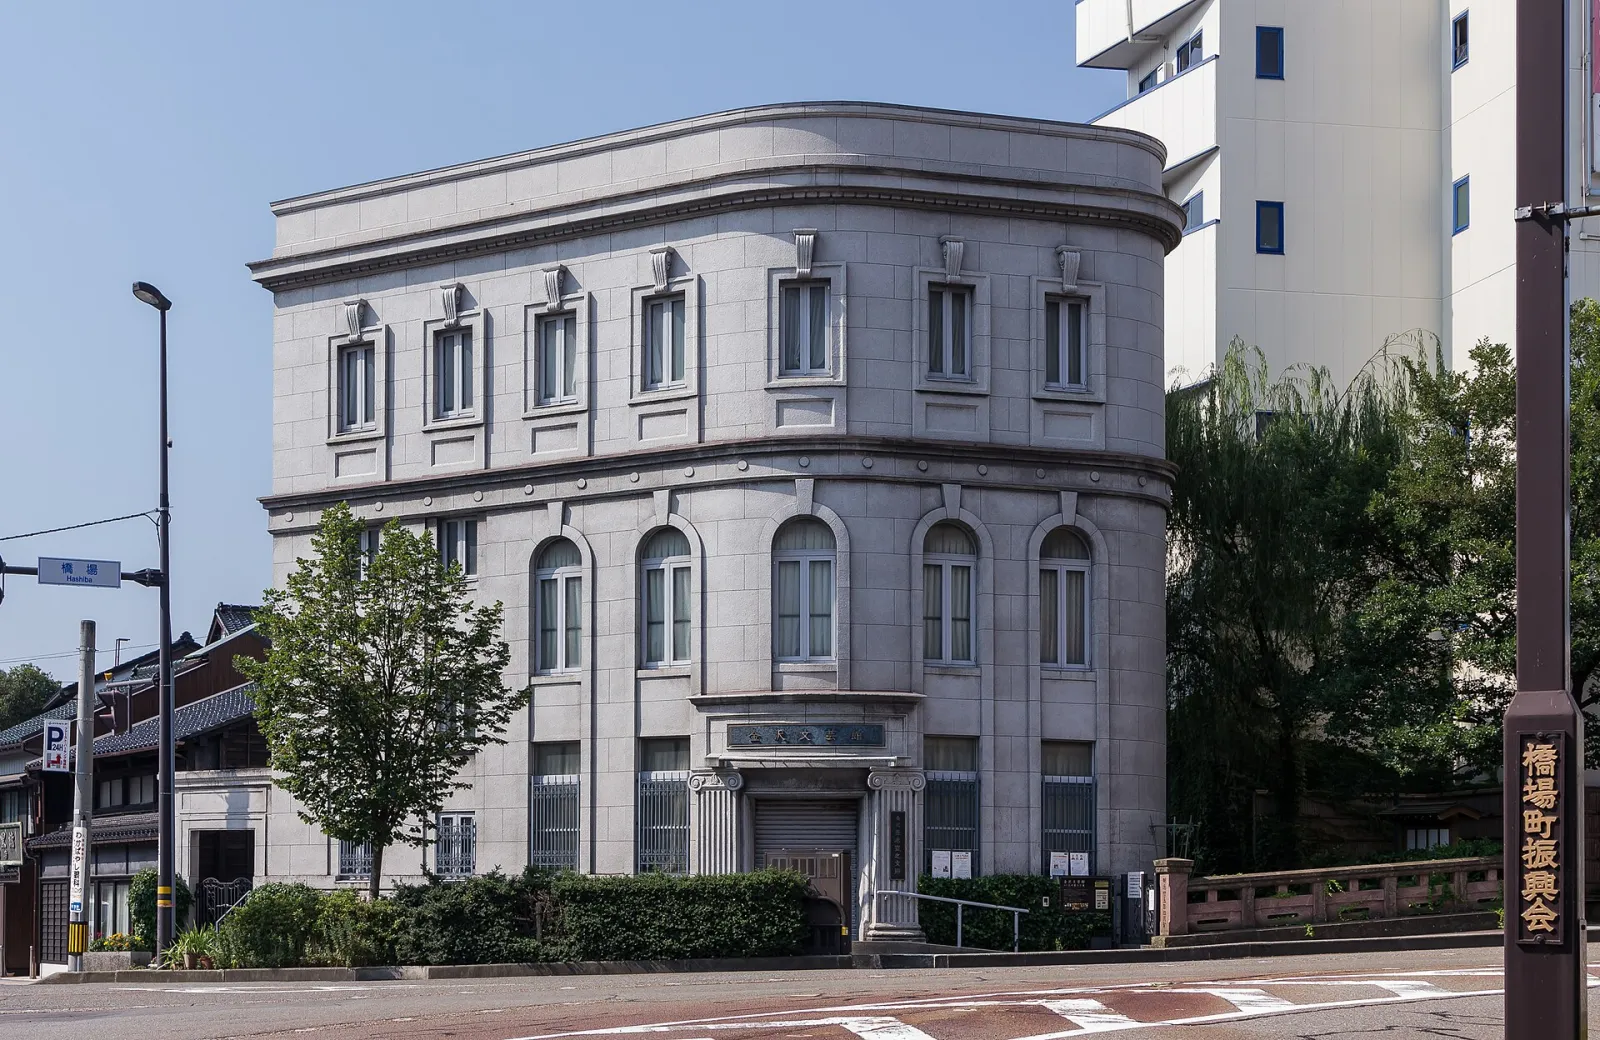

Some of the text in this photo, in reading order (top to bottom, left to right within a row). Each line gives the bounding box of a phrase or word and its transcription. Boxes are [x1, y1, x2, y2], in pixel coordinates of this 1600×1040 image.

[66, 575, 93, 583] Hashiba
[47, 726, 64, 751] P
[52, 743, 64, 752] 24H
[1521, 742, 1560, 932] 橋場町振興会
